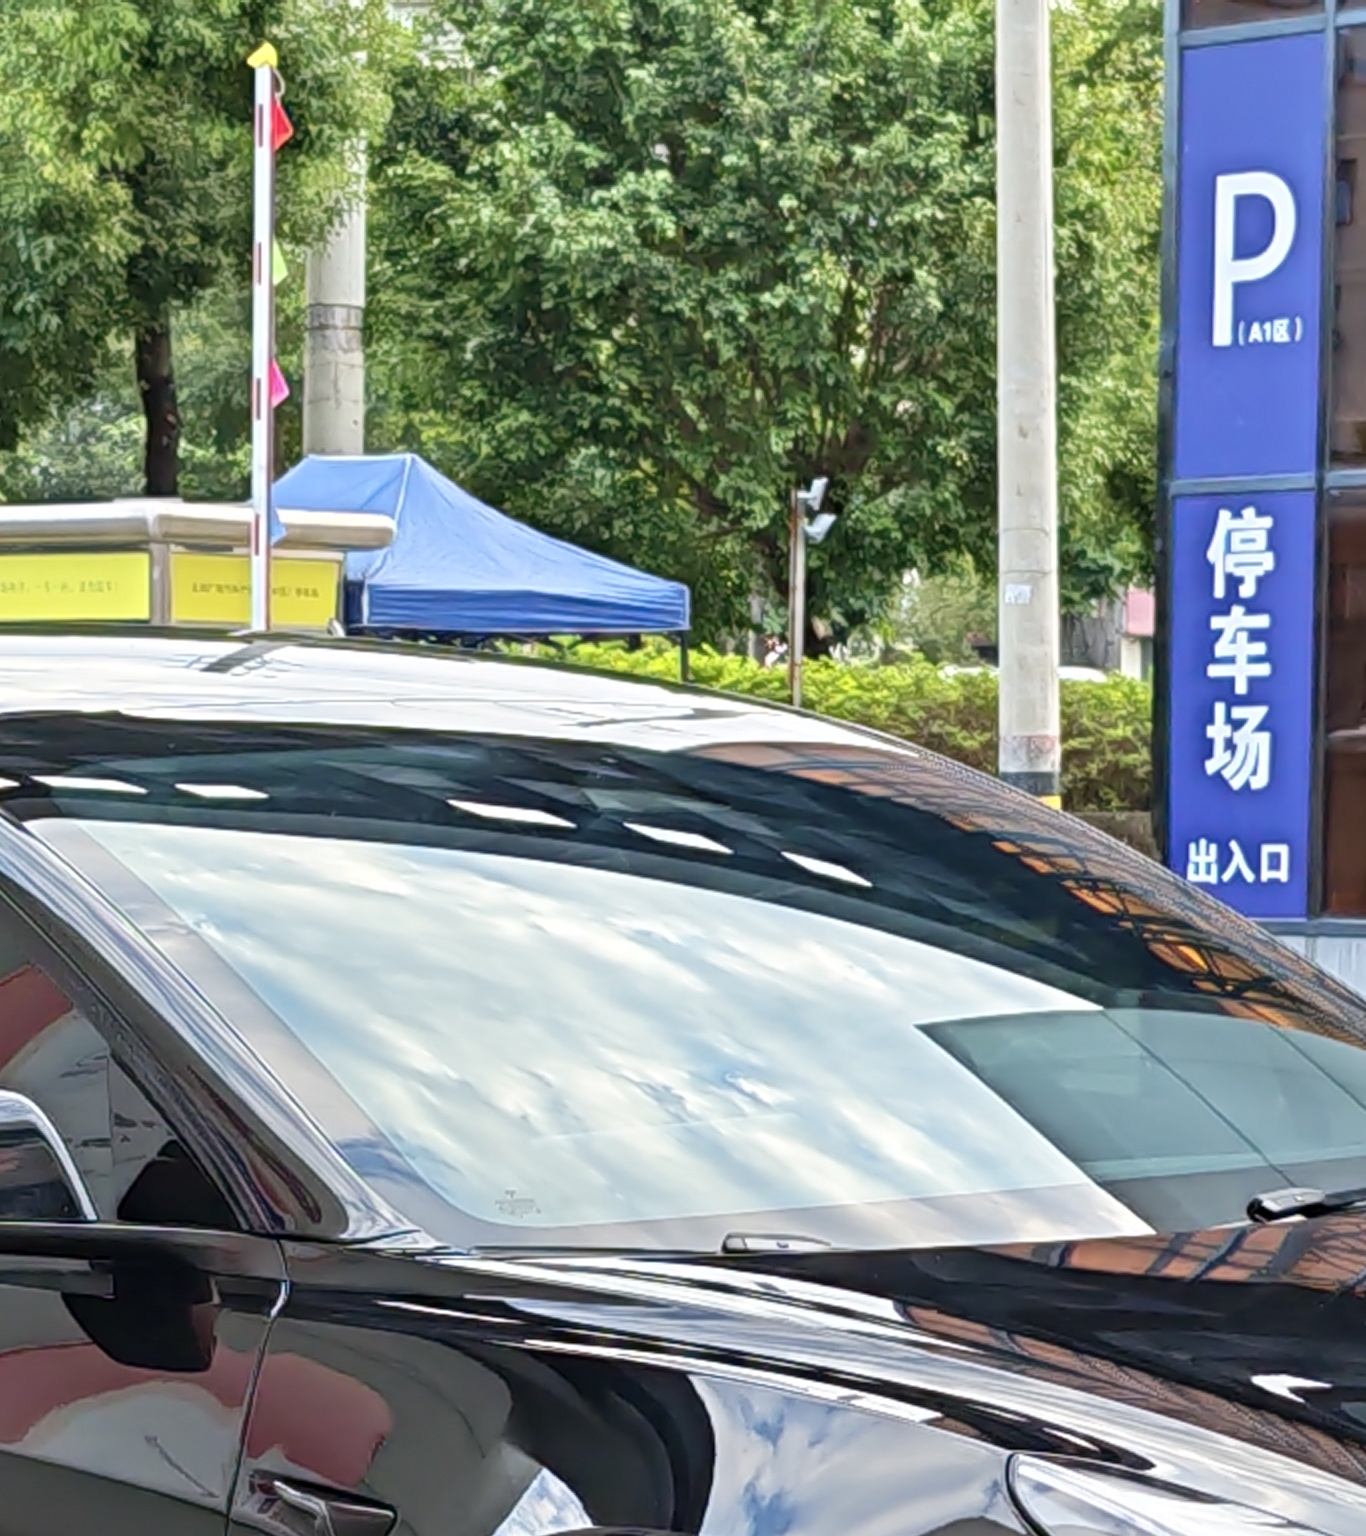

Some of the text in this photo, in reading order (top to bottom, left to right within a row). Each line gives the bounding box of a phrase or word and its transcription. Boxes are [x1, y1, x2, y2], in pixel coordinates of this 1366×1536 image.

[1212, 171, 1296, 347] P
[1205, 506, 1275, 791] 停车场
[1187, 838, 1290, 885] 出入口
